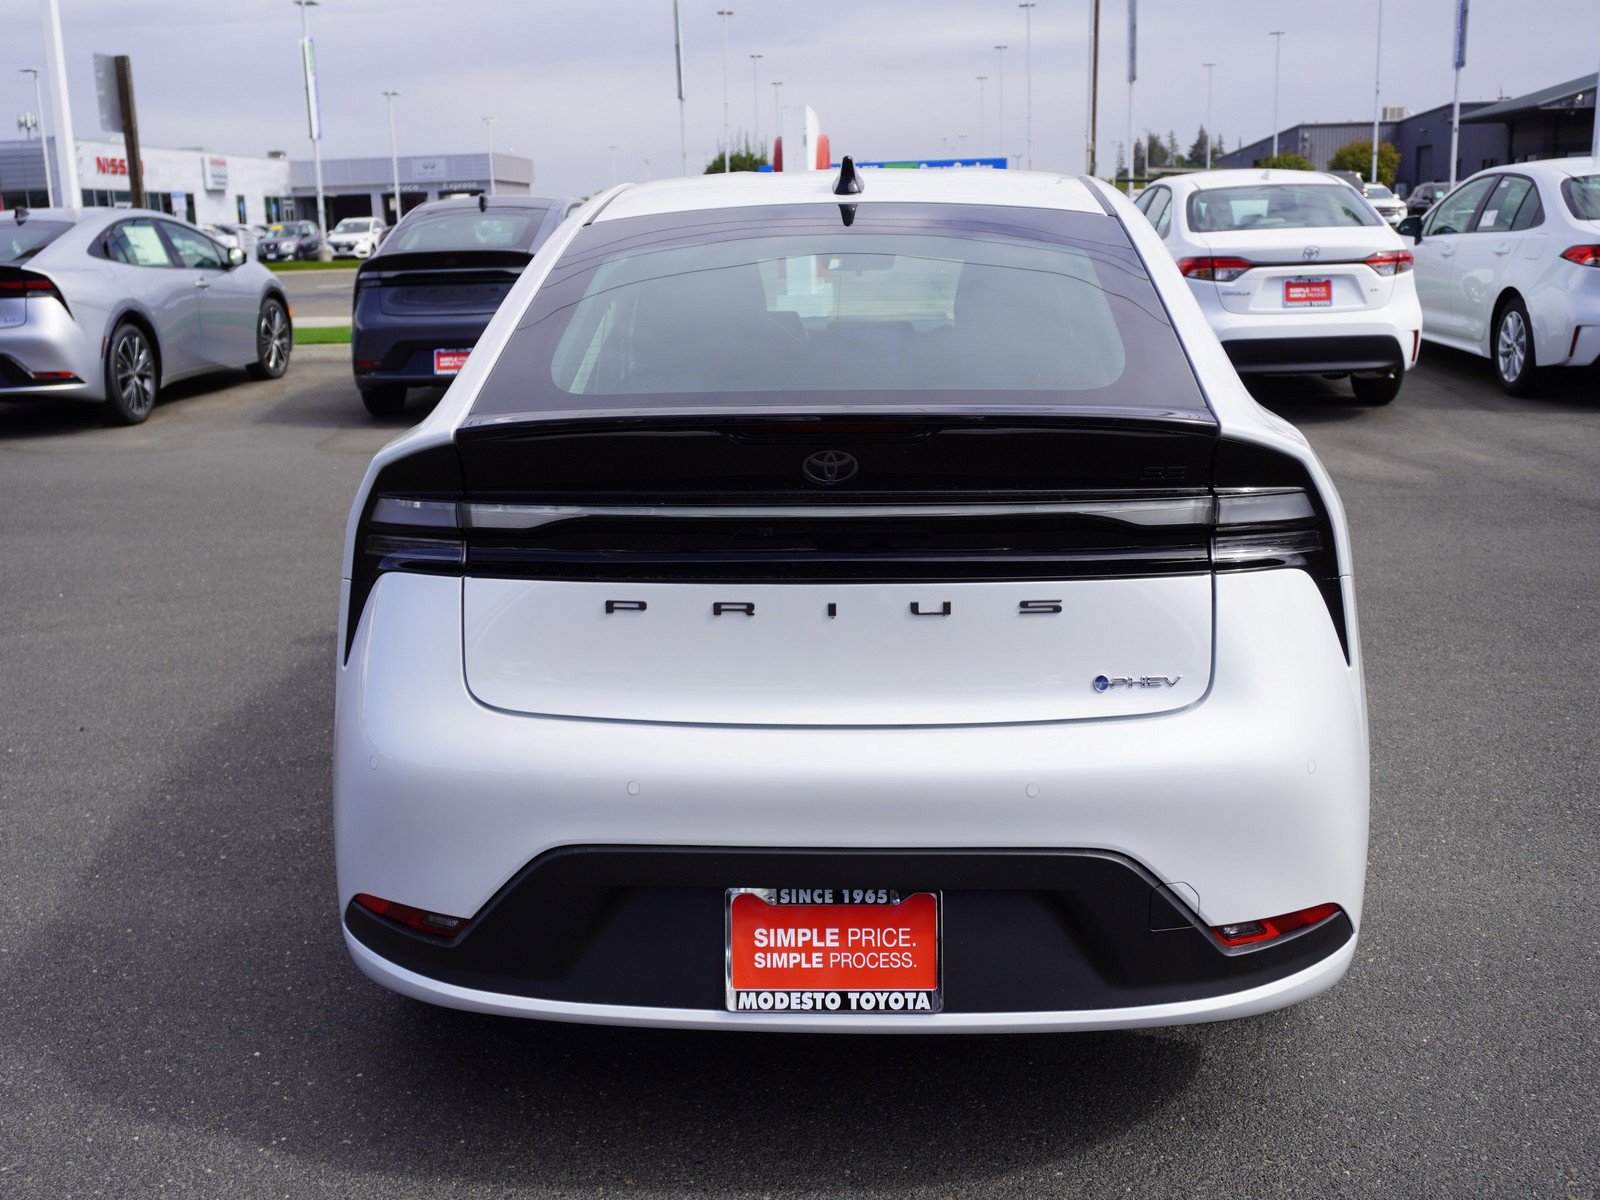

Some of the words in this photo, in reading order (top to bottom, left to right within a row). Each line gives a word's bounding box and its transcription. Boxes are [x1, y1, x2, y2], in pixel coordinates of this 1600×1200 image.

[96, 157, 144, 176] NISS
[442, 182, 478, 191] Express
[604, 599, 1063, 618] PRIUS
[1109, 675, 1184, 688] PHEV
[779, 888, 834, 904] SINCE
[842, 888, 888, 904] 1965
[754, 928, 840, 948] SIMPLE
[847, 928, 917, 947] PRICE.
[754, 952, 824, 969] SIMPLE
[829, 952, 917, 968] PROCESS.
[738, 991, 842, 1011] MODESTO
[848, 992, 931, 1010] TOYOTA
